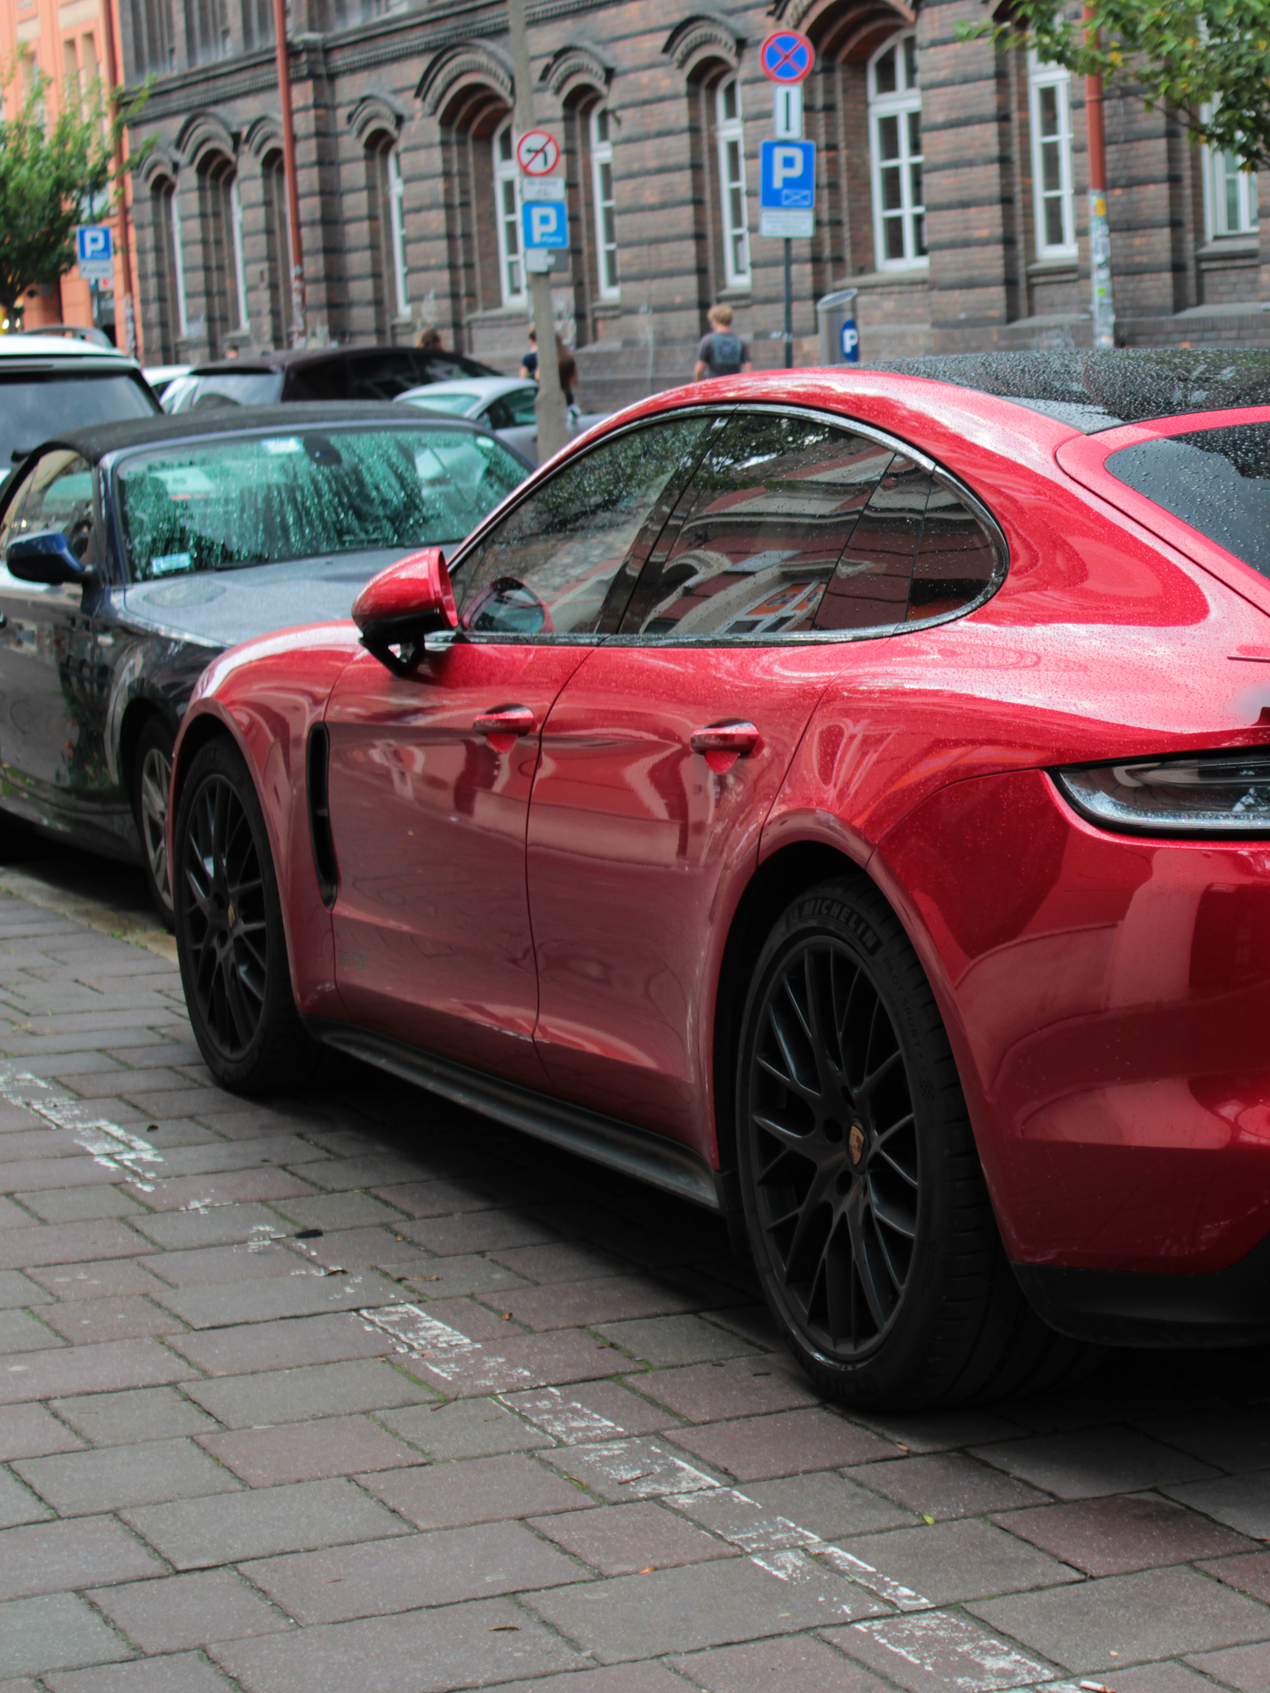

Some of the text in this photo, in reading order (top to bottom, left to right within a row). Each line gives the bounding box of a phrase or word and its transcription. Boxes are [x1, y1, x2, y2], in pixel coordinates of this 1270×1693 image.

[773, 146, 804, 190] P
[84, 230, 106, 258] P
[531, 206, 558, 244] P
[842, 328, 859, 354] P
[801, 898, 879, 950] MICHELIN
[883, 956, 904, 992] PILOT
[902, 998, 923, 1048] SPORT
